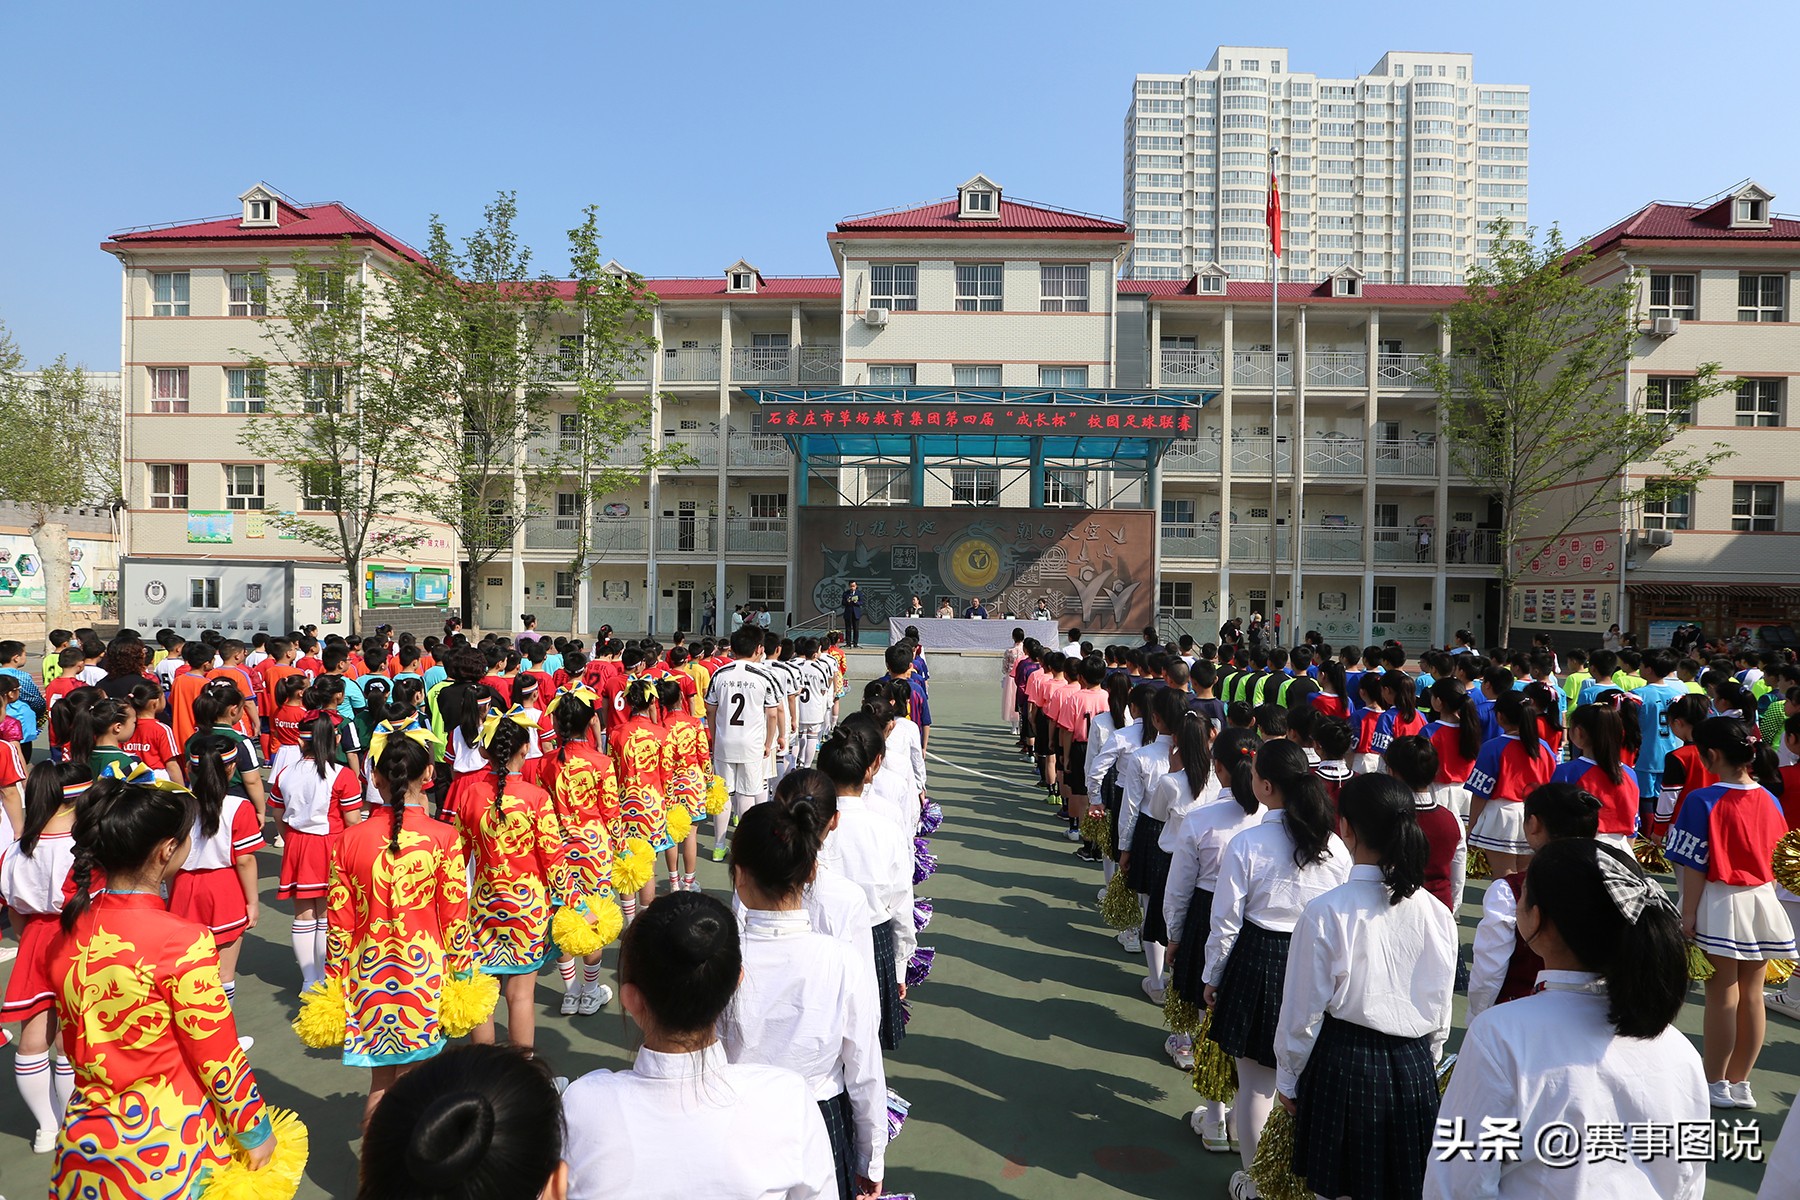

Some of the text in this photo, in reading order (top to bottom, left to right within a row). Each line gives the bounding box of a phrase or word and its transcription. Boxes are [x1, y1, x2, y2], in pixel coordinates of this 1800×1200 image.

[843, 519, 938, 538] 扎根大地
[1016, 521, 1101, 541] 朝向天空
[613, 690, 626, 712] 6
[730, 693, 746, 727] 2
